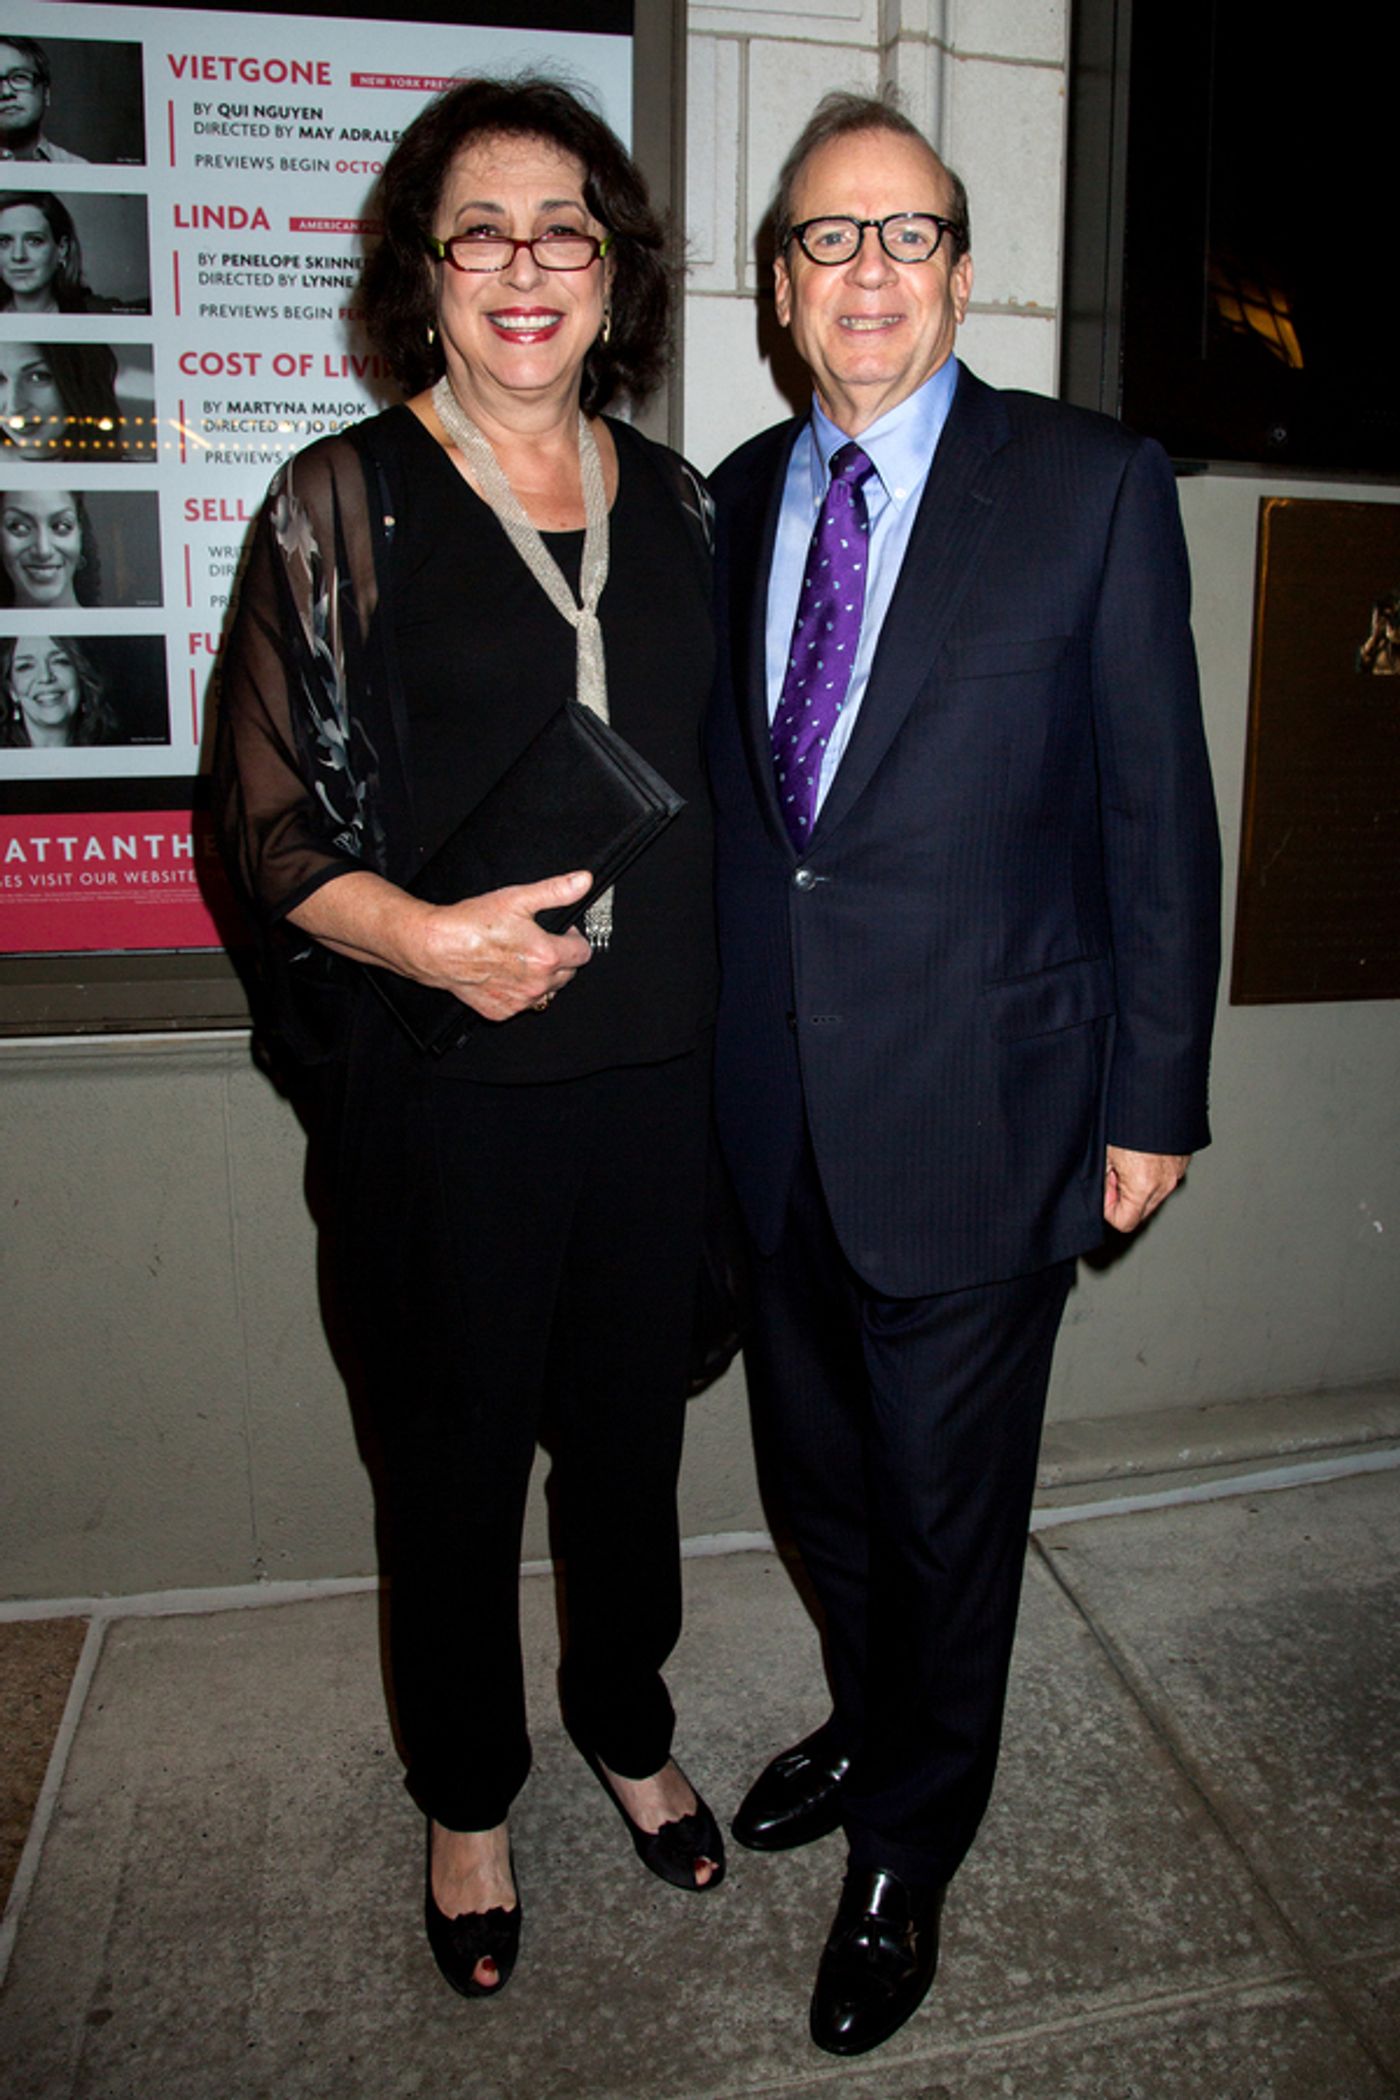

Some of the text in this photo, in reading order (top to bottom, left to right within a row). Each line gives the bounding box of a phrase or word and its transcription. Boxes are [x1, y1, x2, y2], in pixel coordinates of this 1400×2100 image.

[167, 53, 333, 85] VIETGONE
[360, 76, 386, 86] NEW
[390, 77, 421, 87] YORK
[194, 102, 323, 120] BY QUI NGUYEN
[194, 121, 270, 138] DIRECTED
[275, 124, 293, 139] BY
[299, 126, 334, 141] MAY
[195, 154, 275, 170] PREVIEWS
[280, 156, 330, 172] BEGIN
[173, 203, 271, 231] LINDA
[299, 220, 360, 232] AMERICAN
[199, 253, 217, 267] BY
[222, 254, 300, 269] PENELOPE
[199, 272, 353, 289] DIRECTED BY LYNNE
[200, 304, 279, 320] PREVIEWS
[284, 305, 333, 321] BEGIN
[178, 351, 262, 377] COST
[272, 352, 314, 378] OF
[203, 401, 367, 418] BY MARTYNA MAJOK
[203, 419, 278, 433] DIRECTED
[305, 420, 325, 434] JO
[205, 450, 283, 465] PREVIEWS
[184, 498, 251, 522] SELL
[29, 872, 73, 887] VISIT
[79, 871, 118, 886] OUR
[123, 868, 197, 884] WEBSITE
